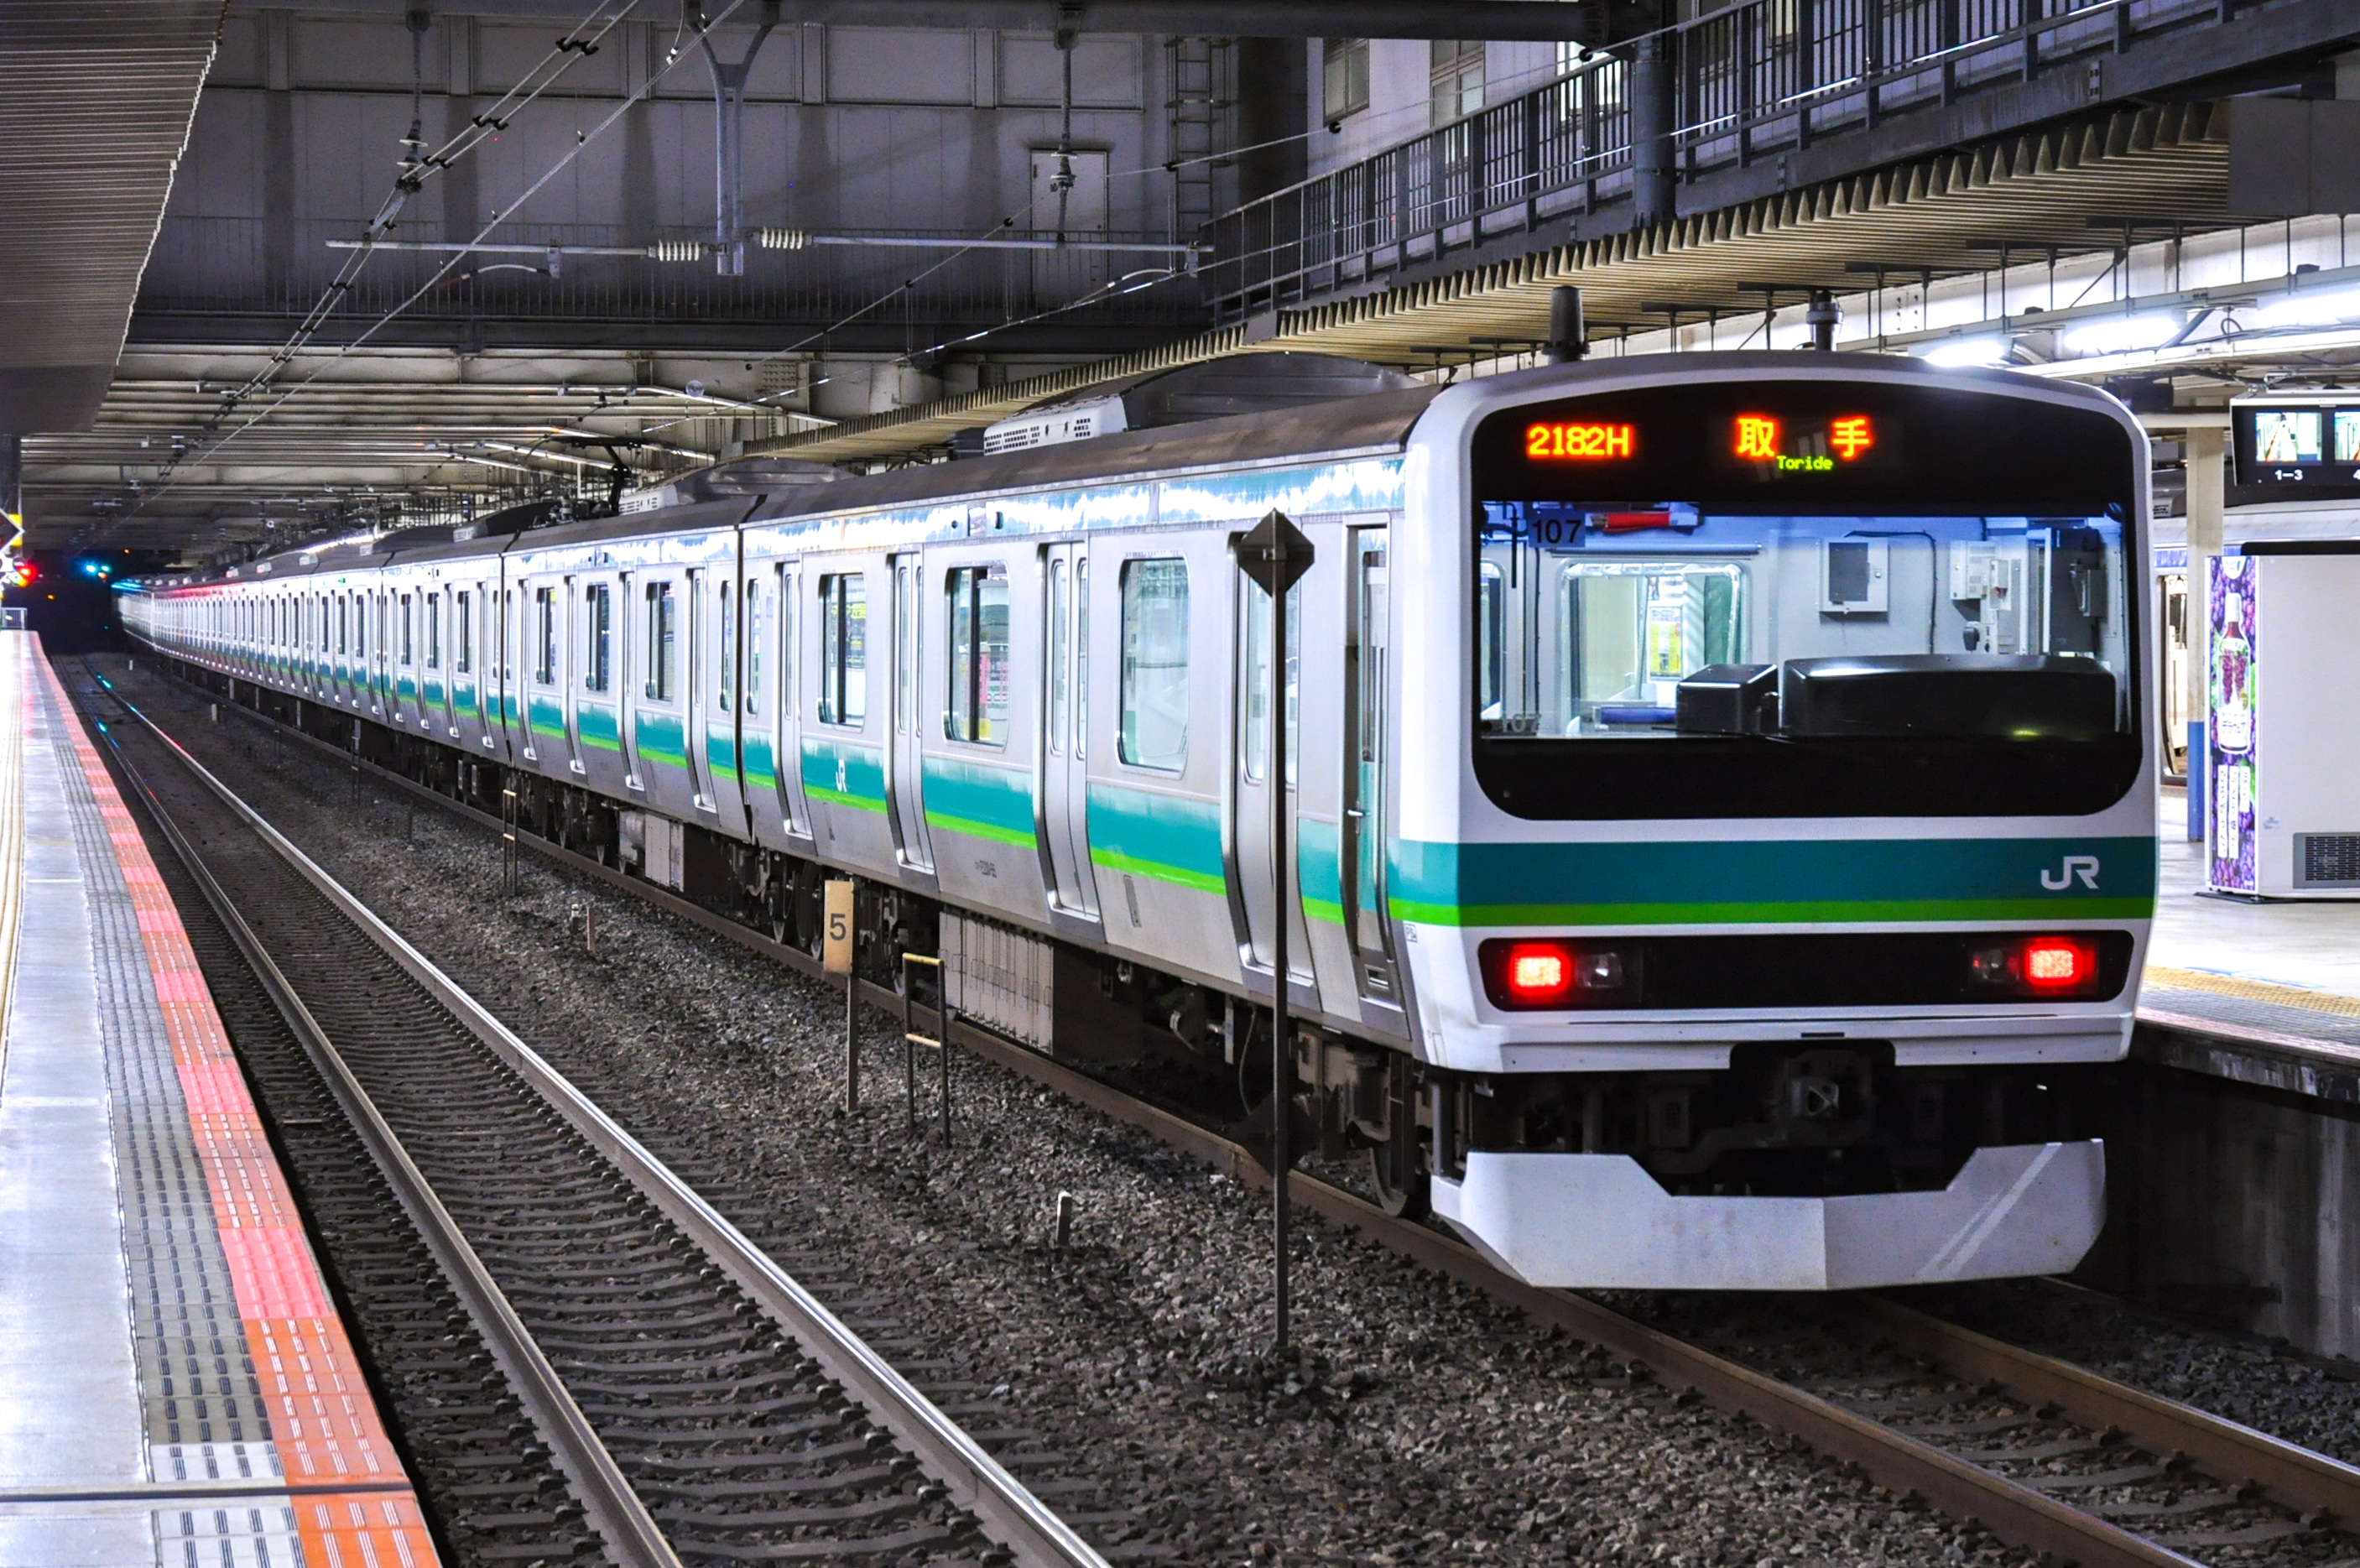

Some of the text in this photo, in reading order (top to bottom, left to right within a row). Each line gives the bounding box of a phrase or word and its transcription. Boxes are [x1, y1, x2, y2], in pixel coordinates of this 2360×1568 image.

[1529, 425, 1629, 456] 2182H
[1737, 418, 1870, 457] 取手
[1776, 455, 1833, 470] Toride
[1532, 518, 1582, 544] 107
[1499, 712, 1542, 733] 107
[835, 758, 847, 793] JR
[2040, 855, 2100, 890] JR
[829, 913, 847, 941] 5
